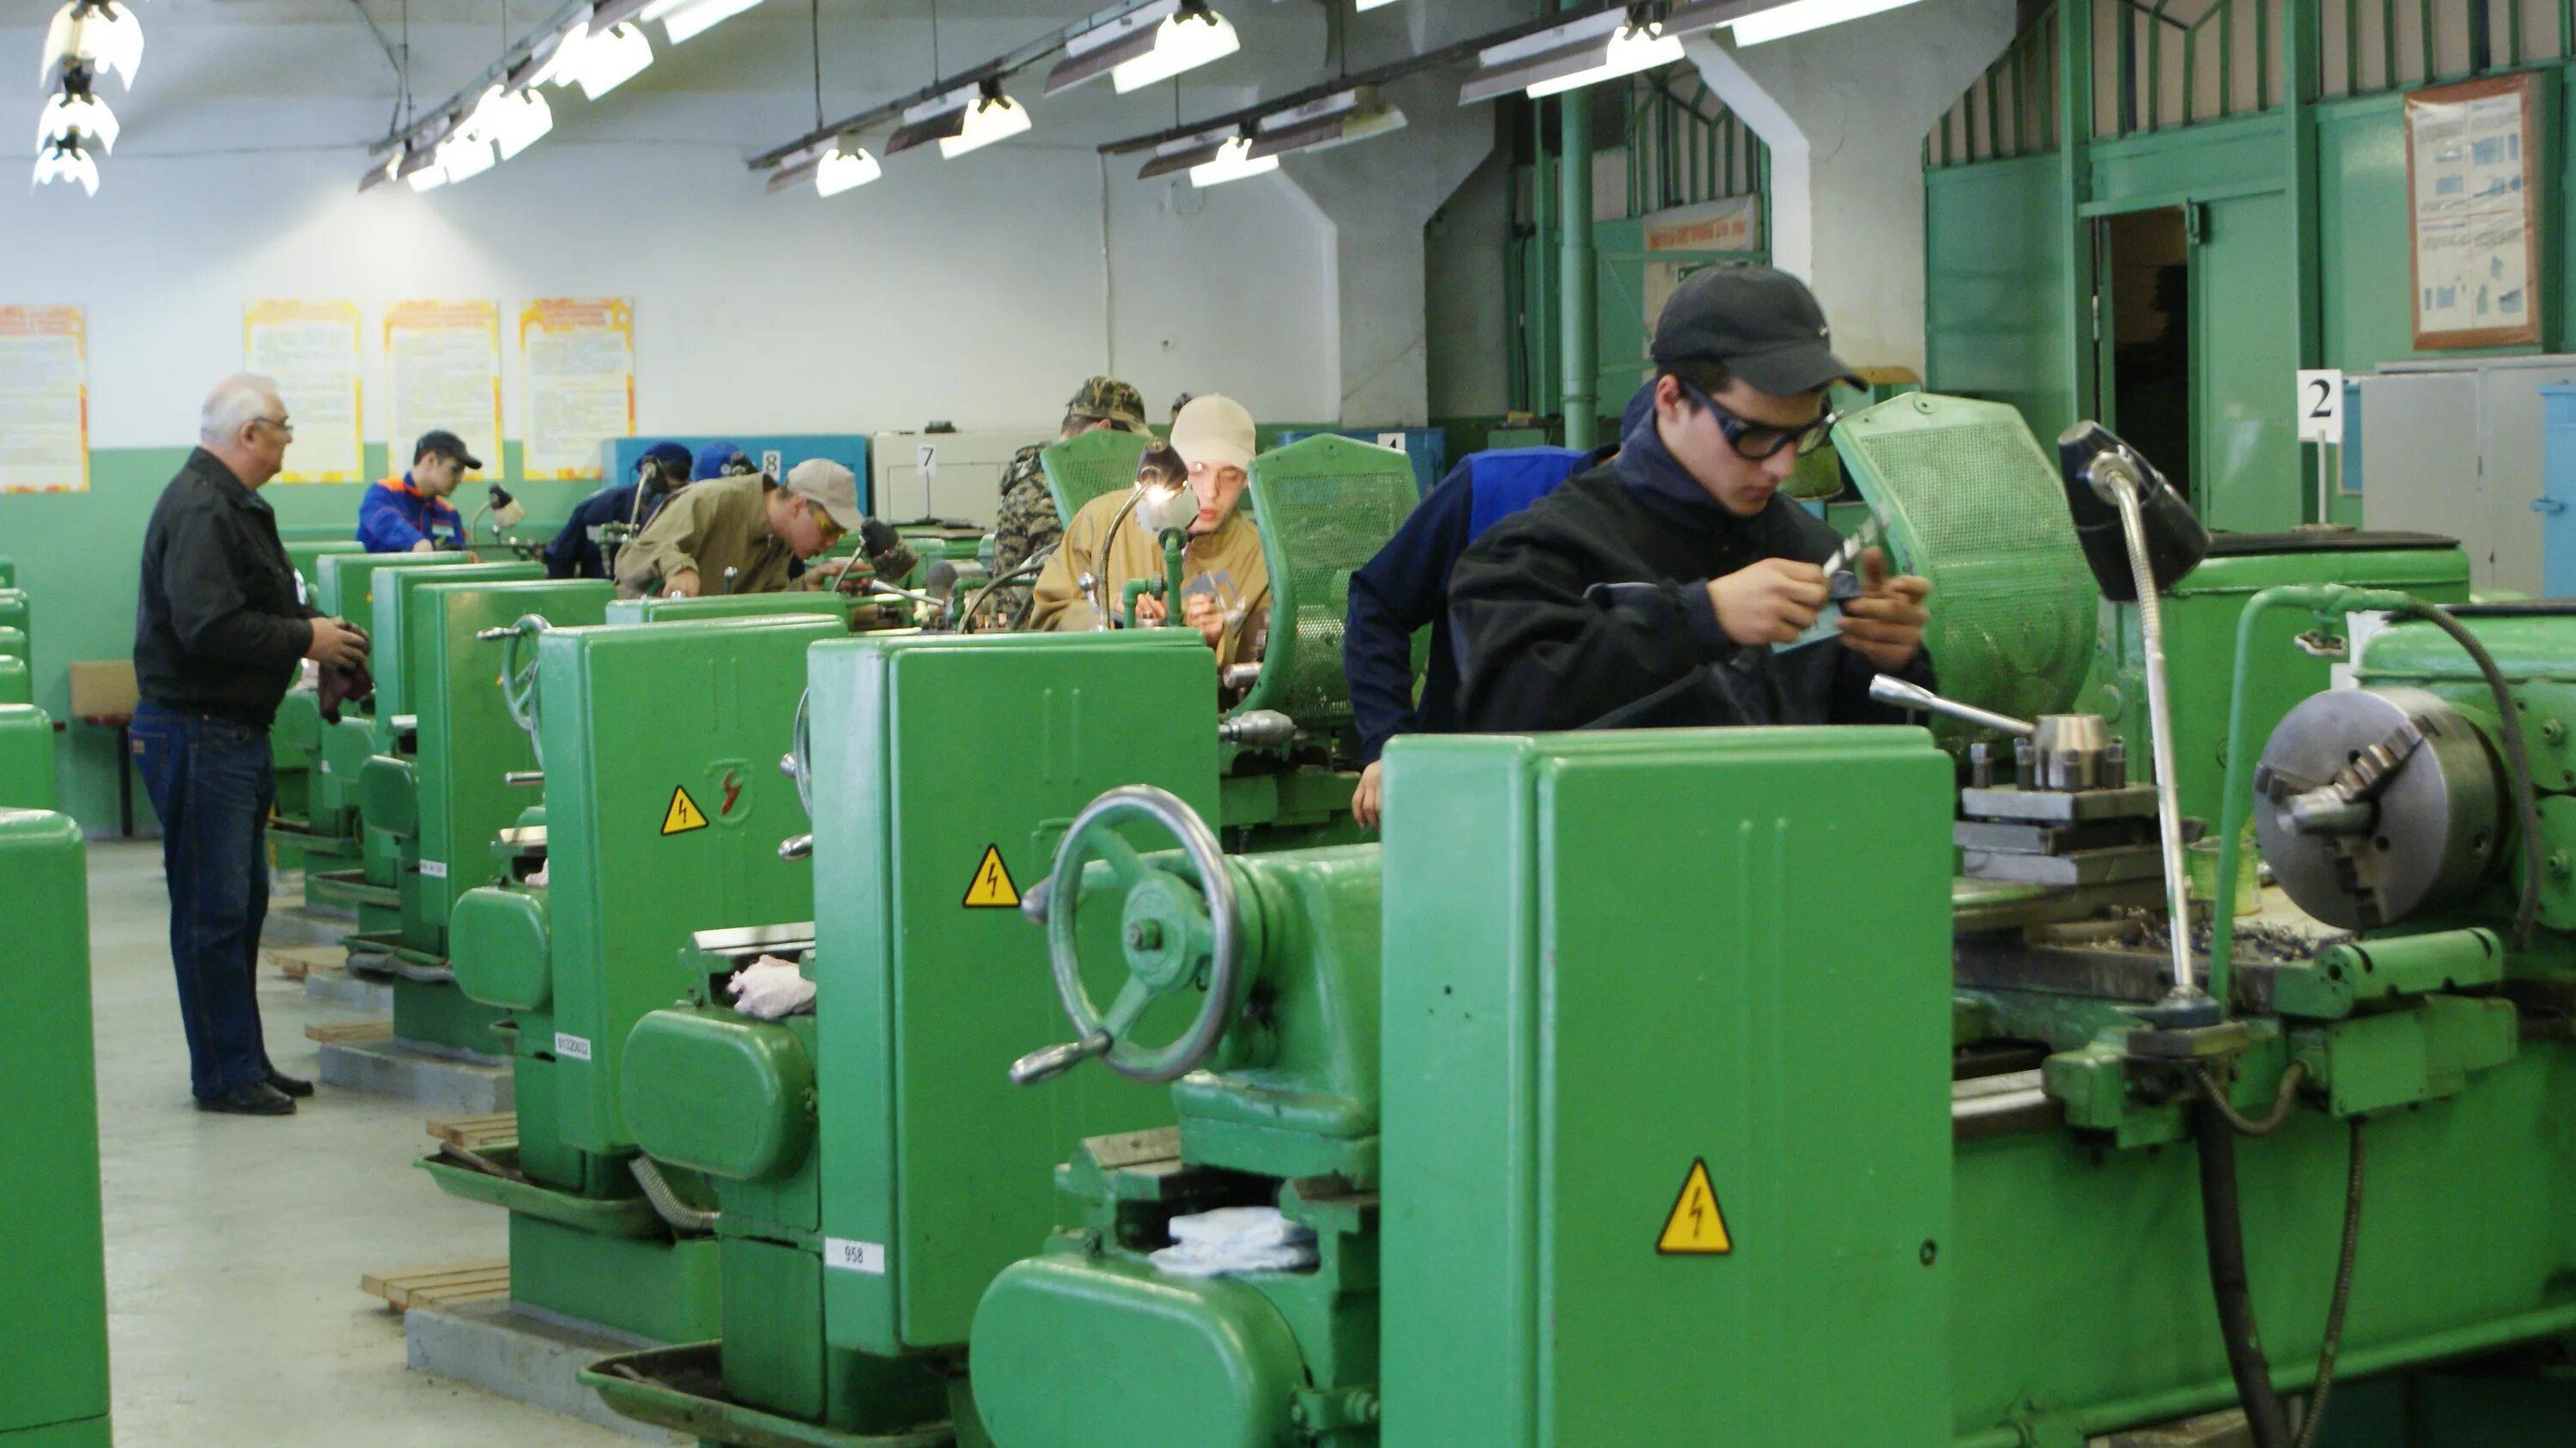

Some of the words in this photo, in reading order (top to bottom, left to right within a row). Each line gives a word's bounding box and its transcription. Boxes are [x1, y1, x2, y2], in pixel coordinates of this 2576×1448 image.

[2307, 379, 2332, 418] 2
[766, 454, 777, 472] 8
[921, 447, 933, 466] 7
[845, 1245, 863, 1264] 958
